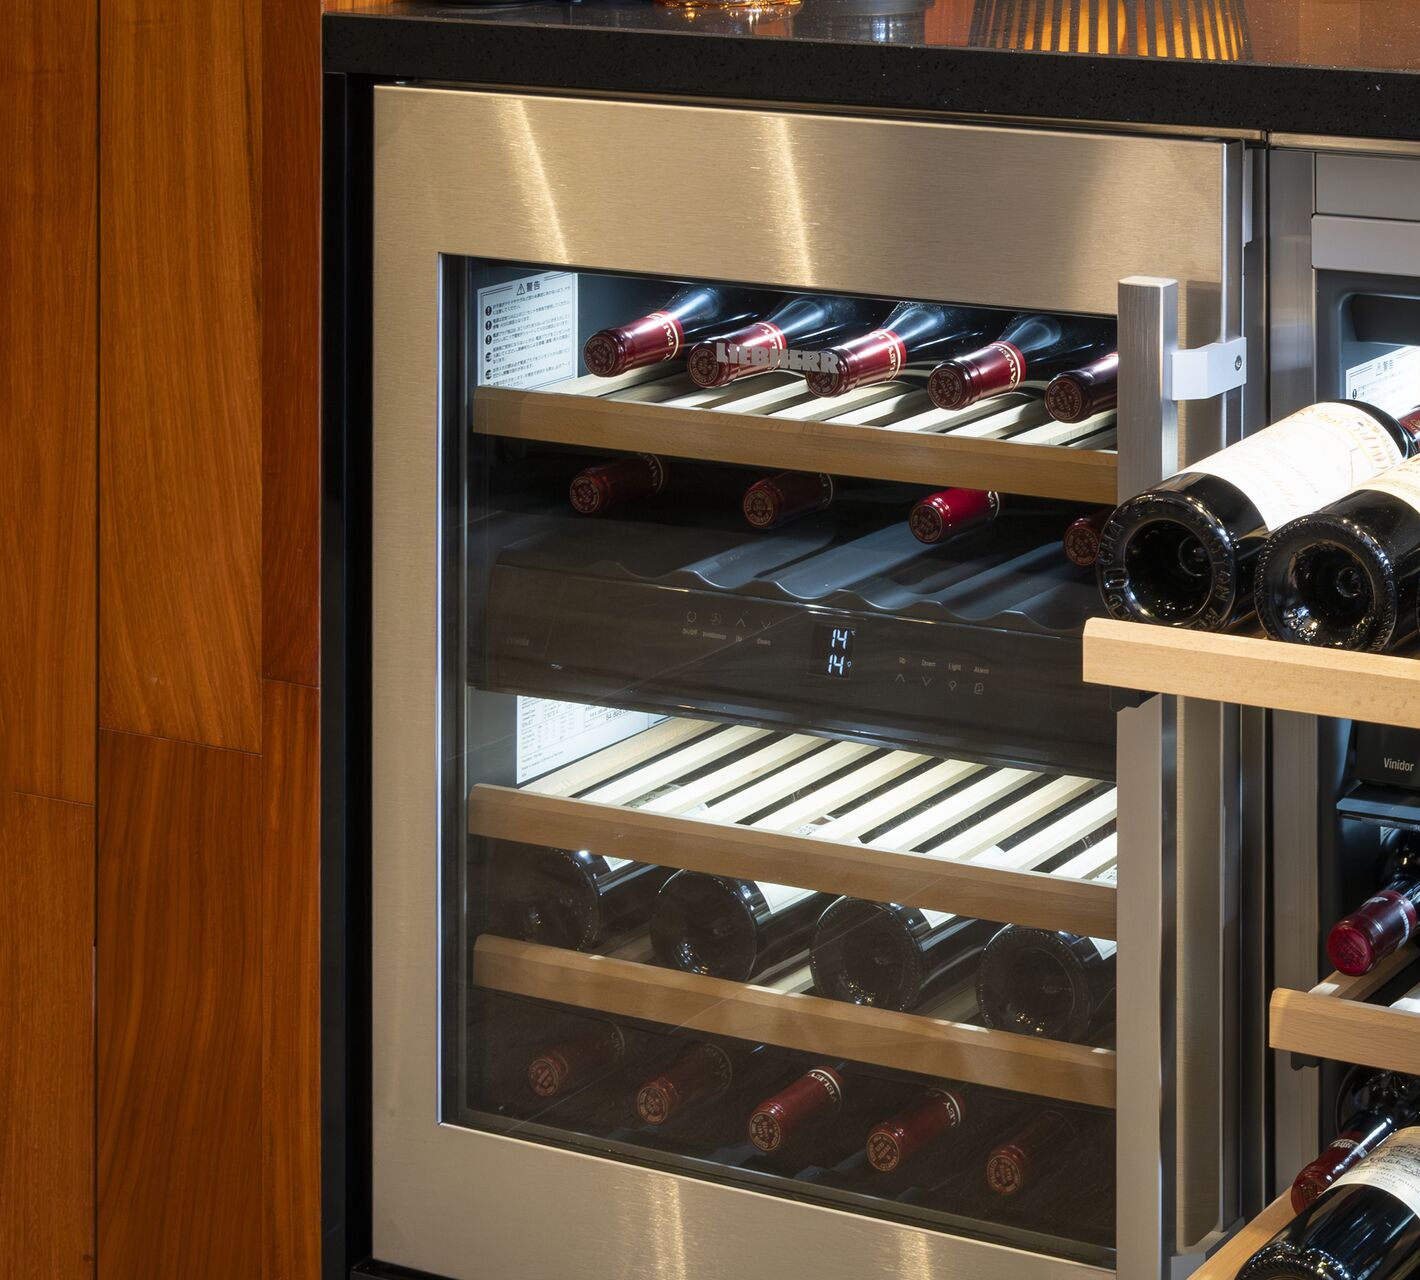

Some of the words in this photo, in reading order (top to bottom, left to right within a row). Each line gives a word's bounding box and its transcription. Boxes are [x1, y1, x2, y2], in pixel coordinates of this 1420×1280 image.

[526, 281, 541, 293] 警告
[716, 342, 840, 374] LIEBHERR
[1384, 757, 1415, 772] Vinidor
